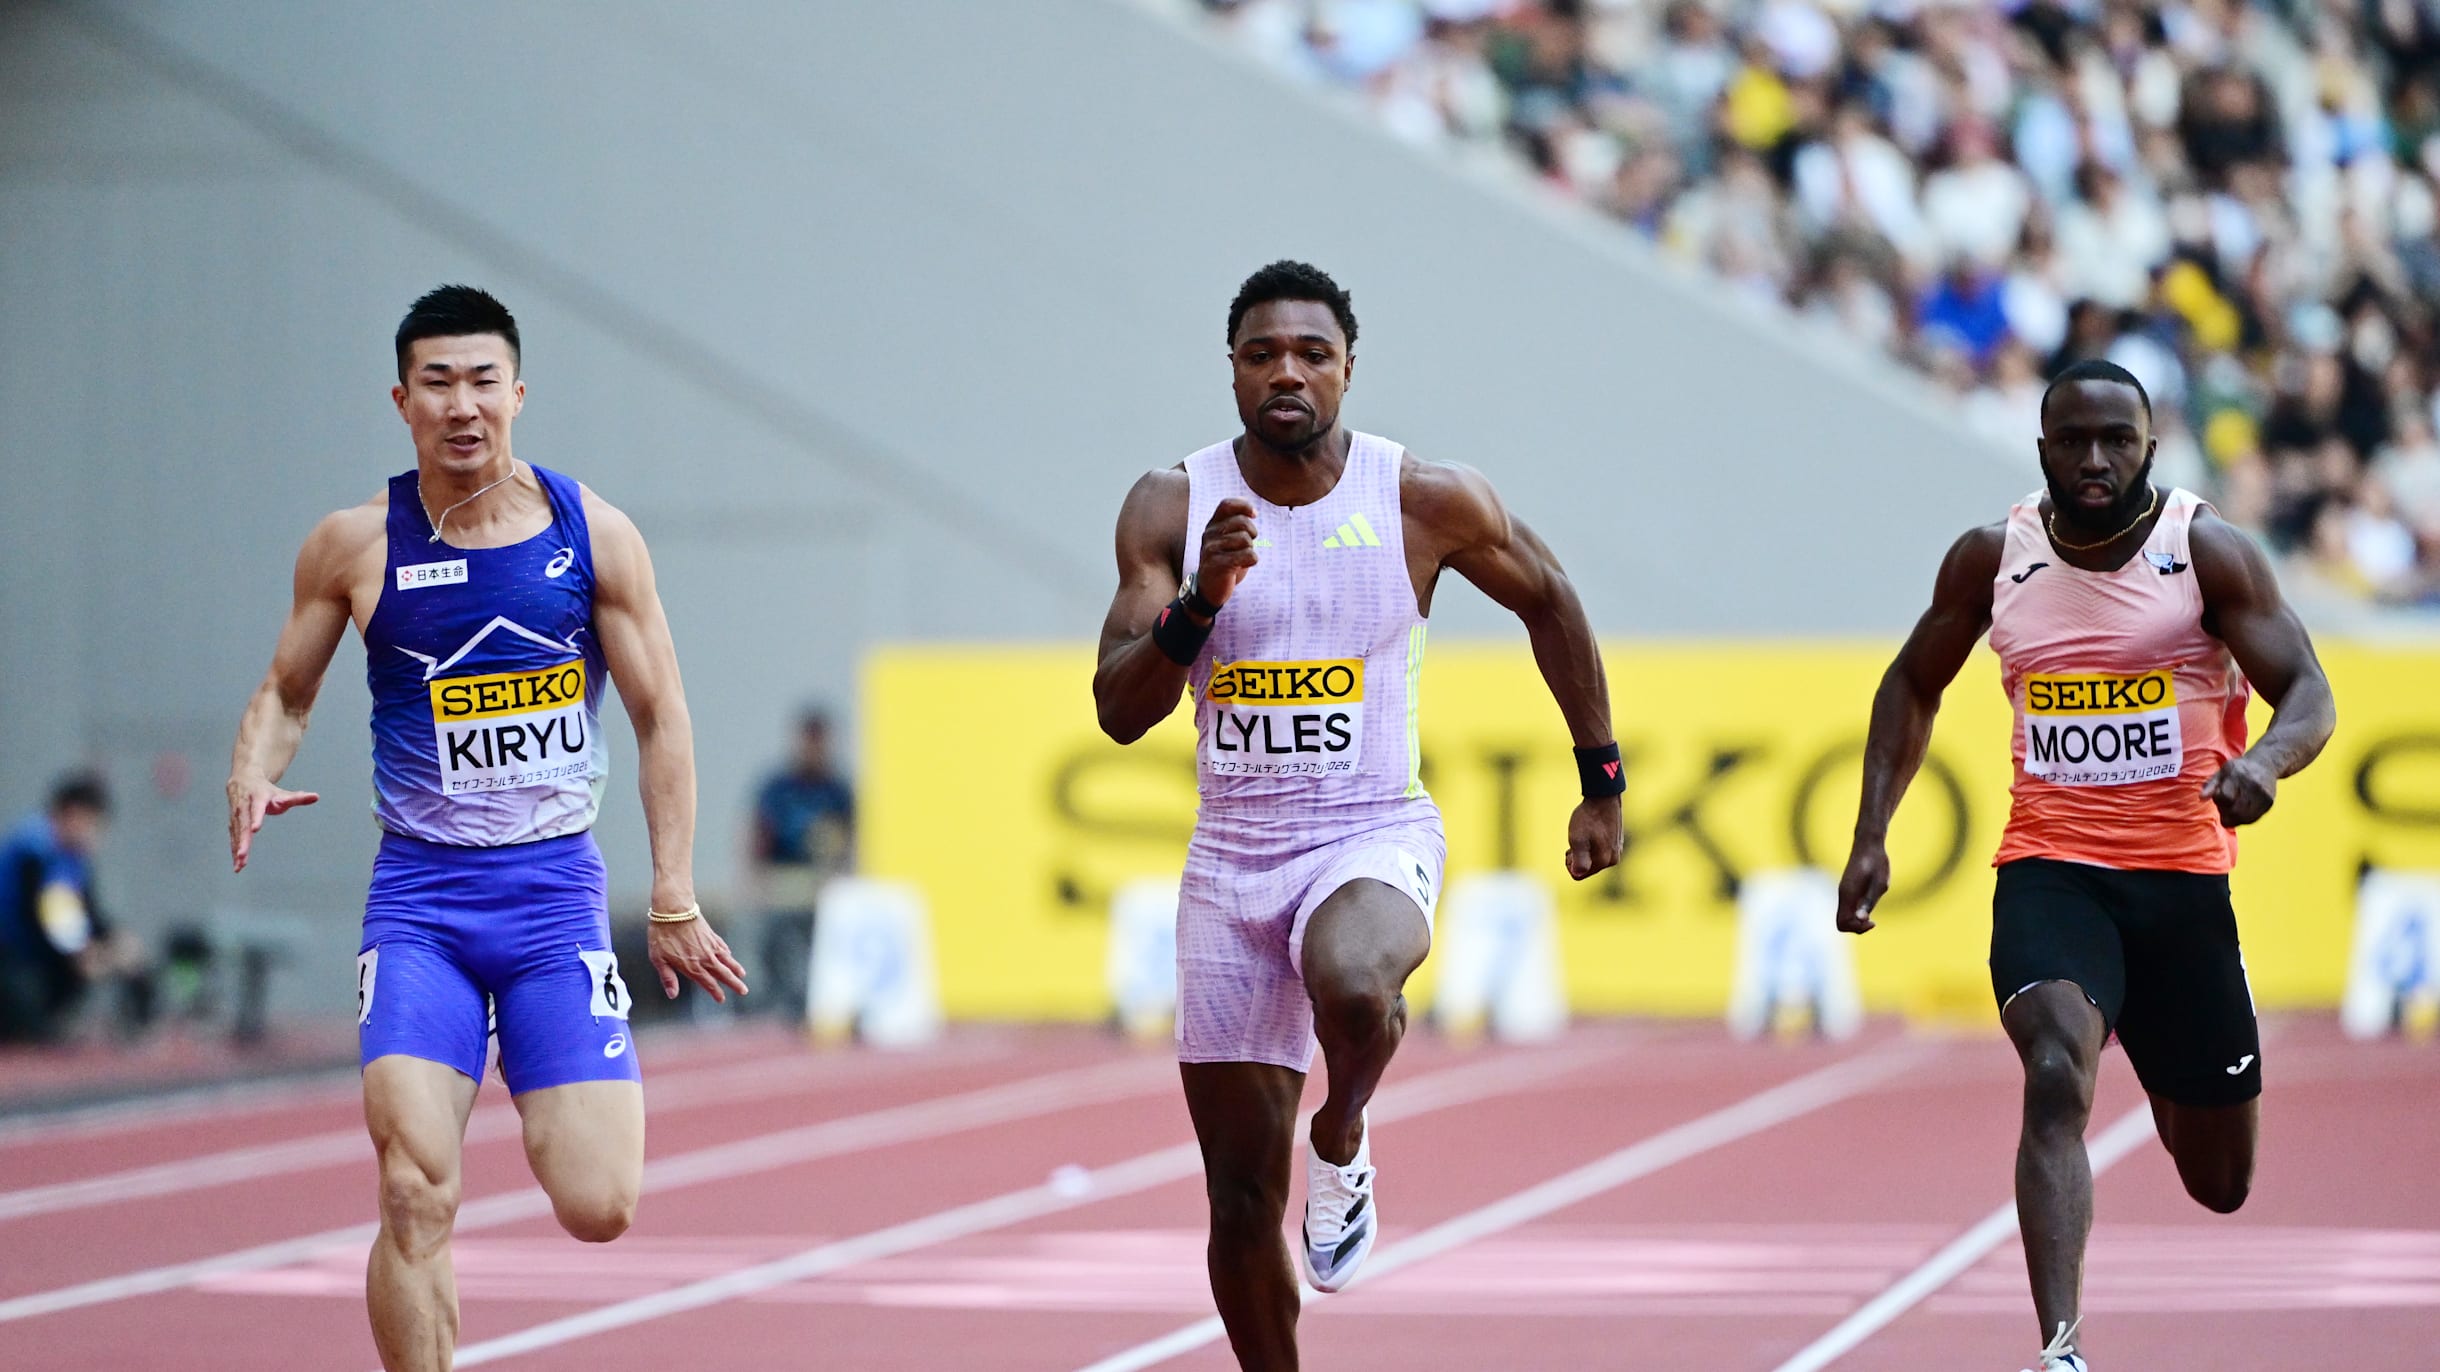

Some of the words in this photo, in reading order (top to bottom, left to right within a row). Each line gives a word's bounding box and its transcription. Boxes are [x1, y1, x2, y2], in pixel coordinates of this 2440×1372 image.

[417, 565, 464, 581] 日本生命
[441, 668, 580, 716] SEIKO
[1211, 665, 1354, 698] SEIKO
[2029, 676, 2165, 710] SEIKO
[447, 711, 585, 771] KIRYU
[1216, 709, 1351, 753] LYLES
[2031, 718, 2172, 763] MOORE
[1054, 738, 1972, 912] SIKO
[1416, 863, 1430, 907] 5
[604, 961, 619, 1011] 6
